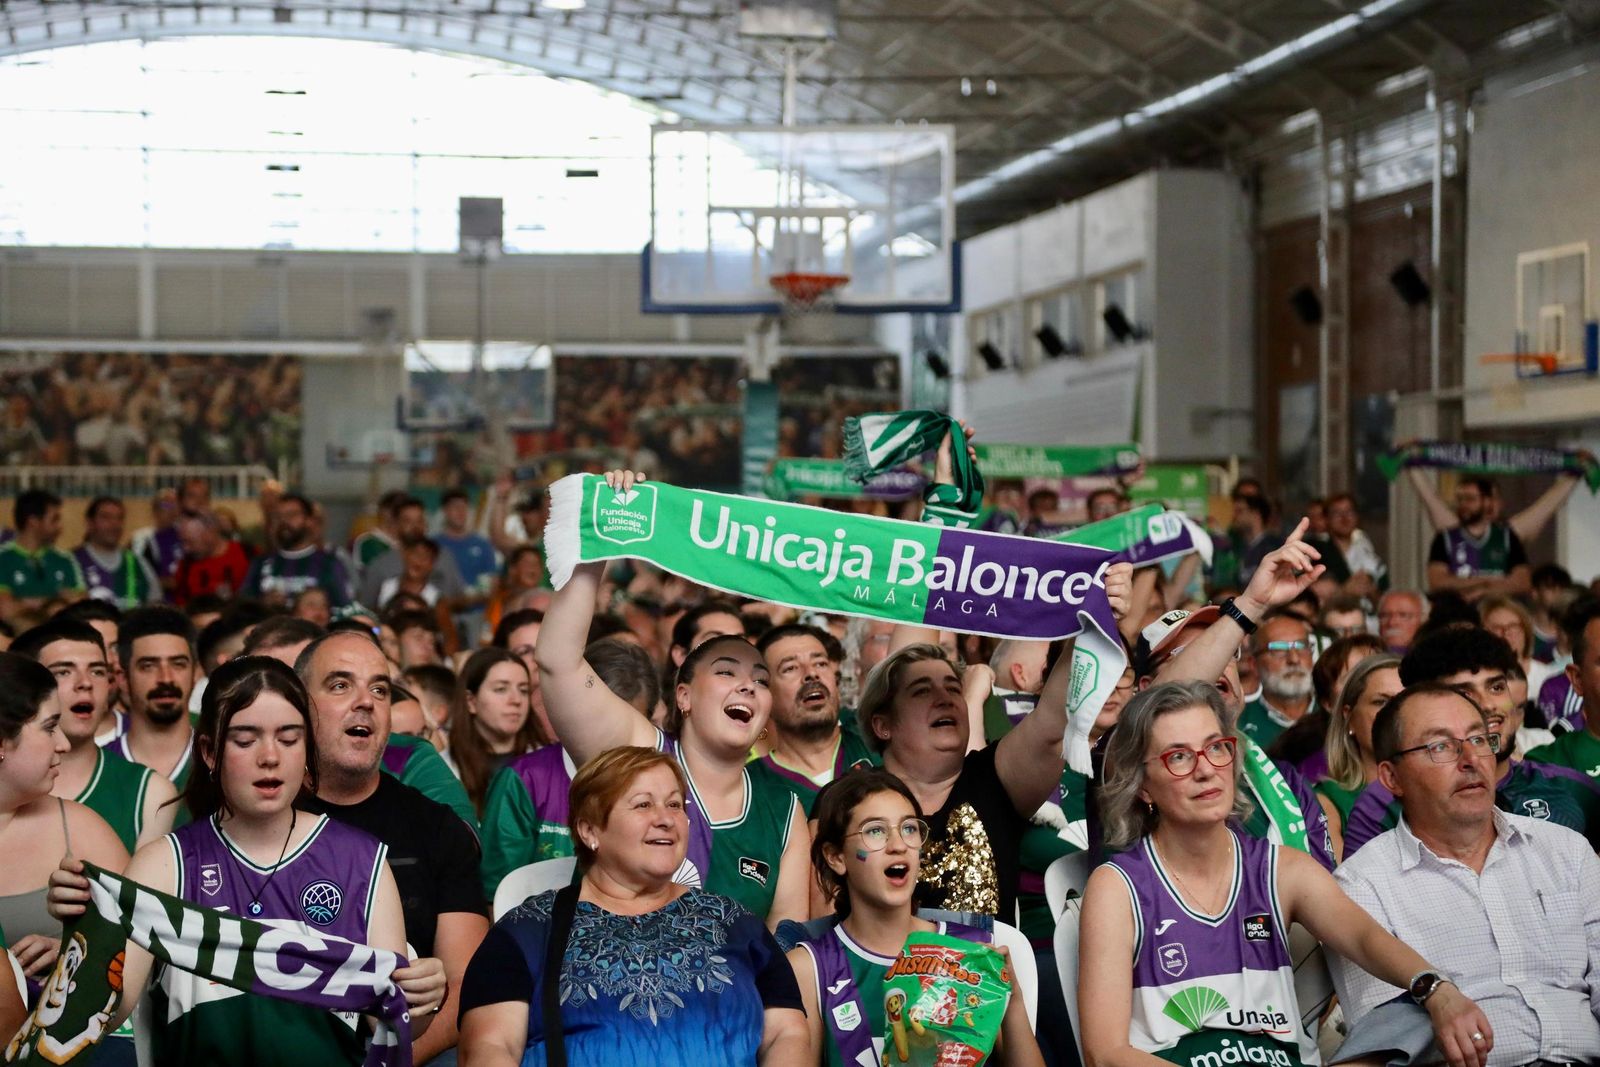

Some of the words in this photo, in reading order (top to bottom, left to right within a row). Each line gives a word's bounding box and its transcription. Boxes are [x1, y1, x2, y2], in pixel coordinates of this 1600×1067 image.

[600, 508, 648, 521] Fundación
[607, 517, 641, 528] Unicaja
[690, 498, 873, 587] Unicaja
[853, 584, 998, 618] MÁLAGA
[1246, 922, 1263, 931] liga
